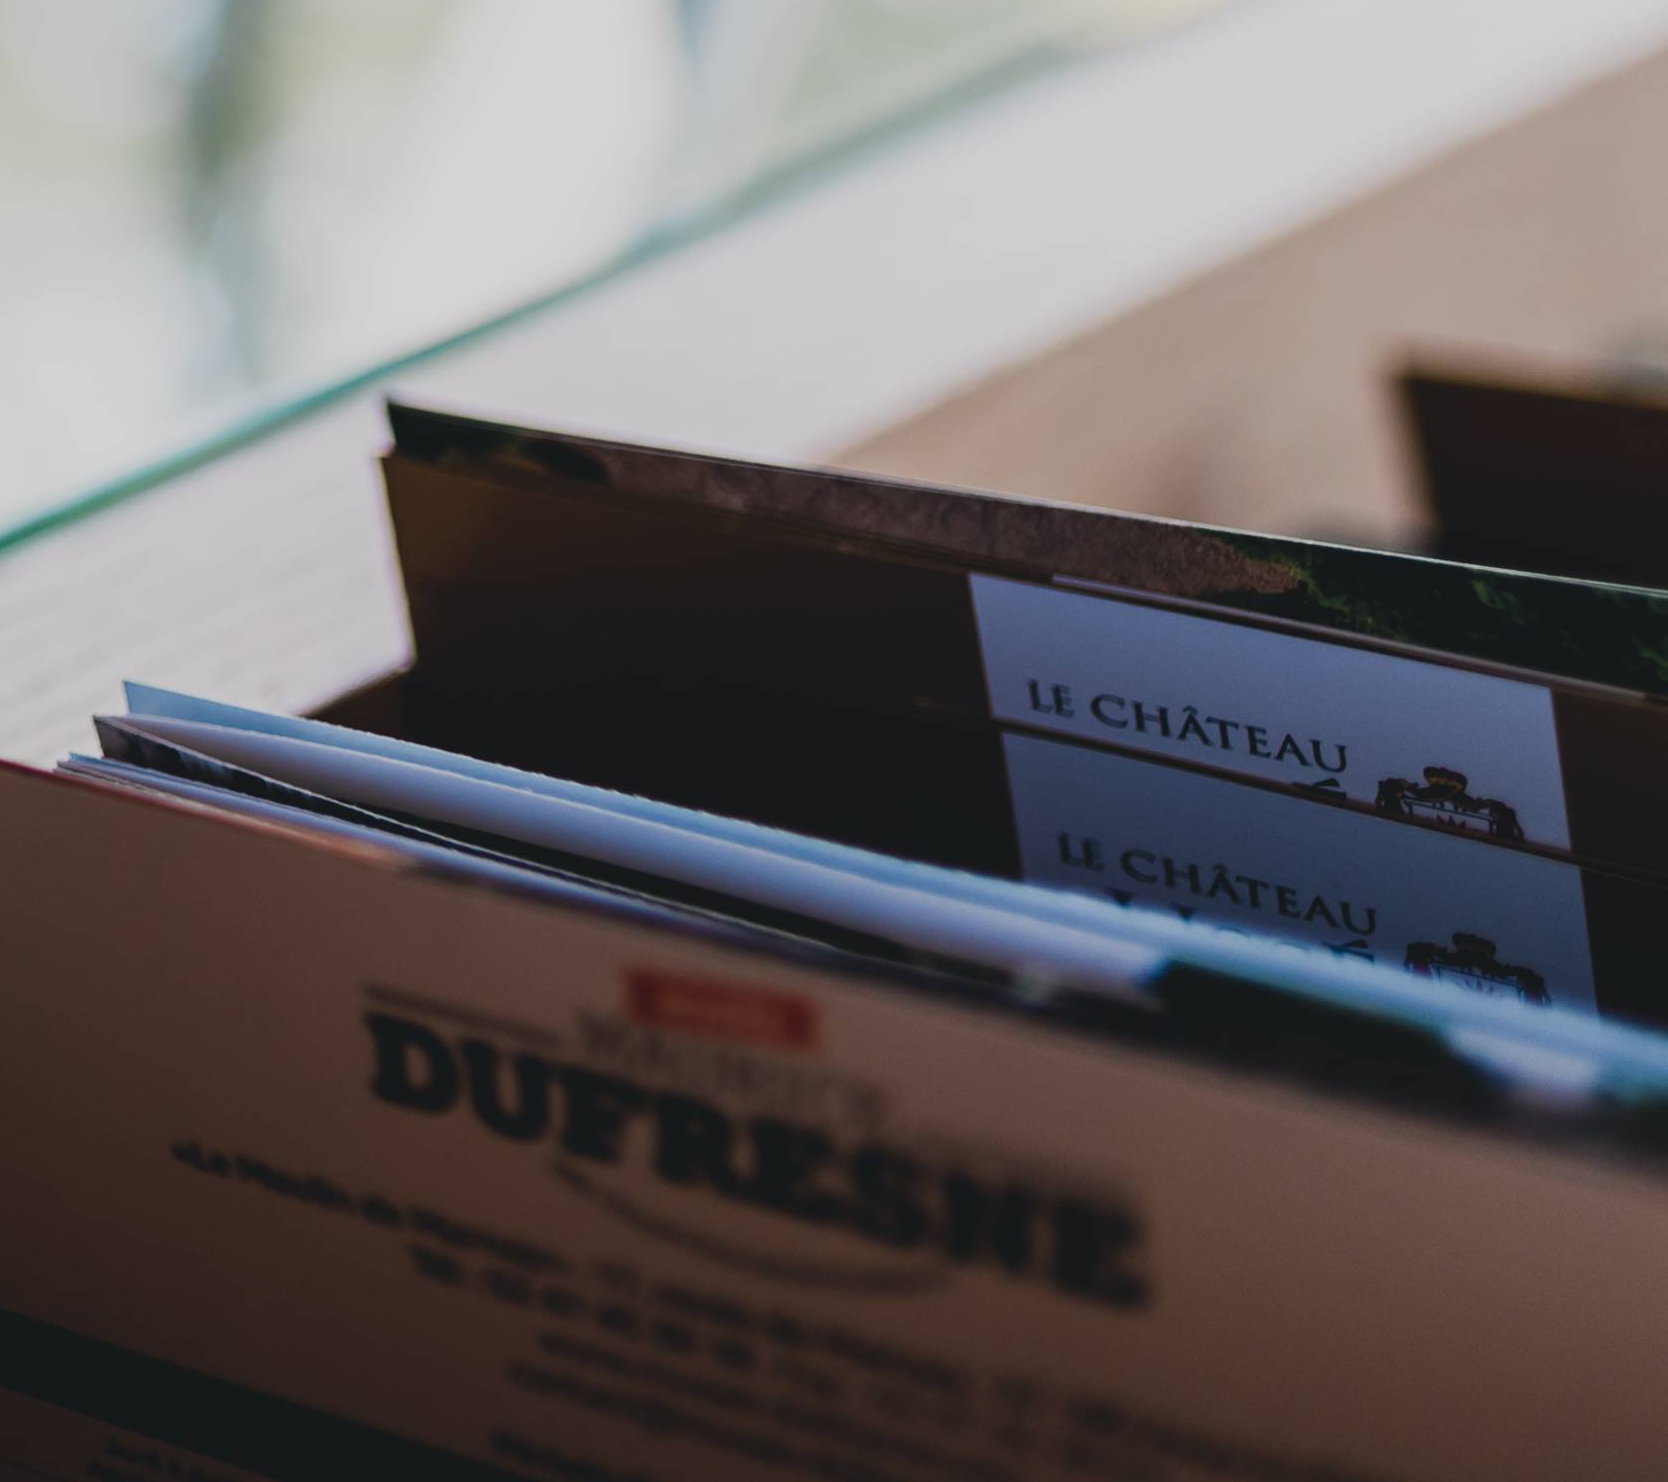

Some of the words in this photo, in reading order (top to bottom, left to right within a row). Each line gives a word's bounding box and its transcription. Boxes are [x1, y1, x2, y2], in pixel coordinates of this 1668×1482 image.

[1028, 678, 1075, 718] LE
[1090, 692, 1348, 773] CHÂTEAU
[1057, 832, 1104, 872] LE
[1120, 848, 1377, 936] CHÂTEAU
[361, 1005, 1155, 1313] DUFRESNE
